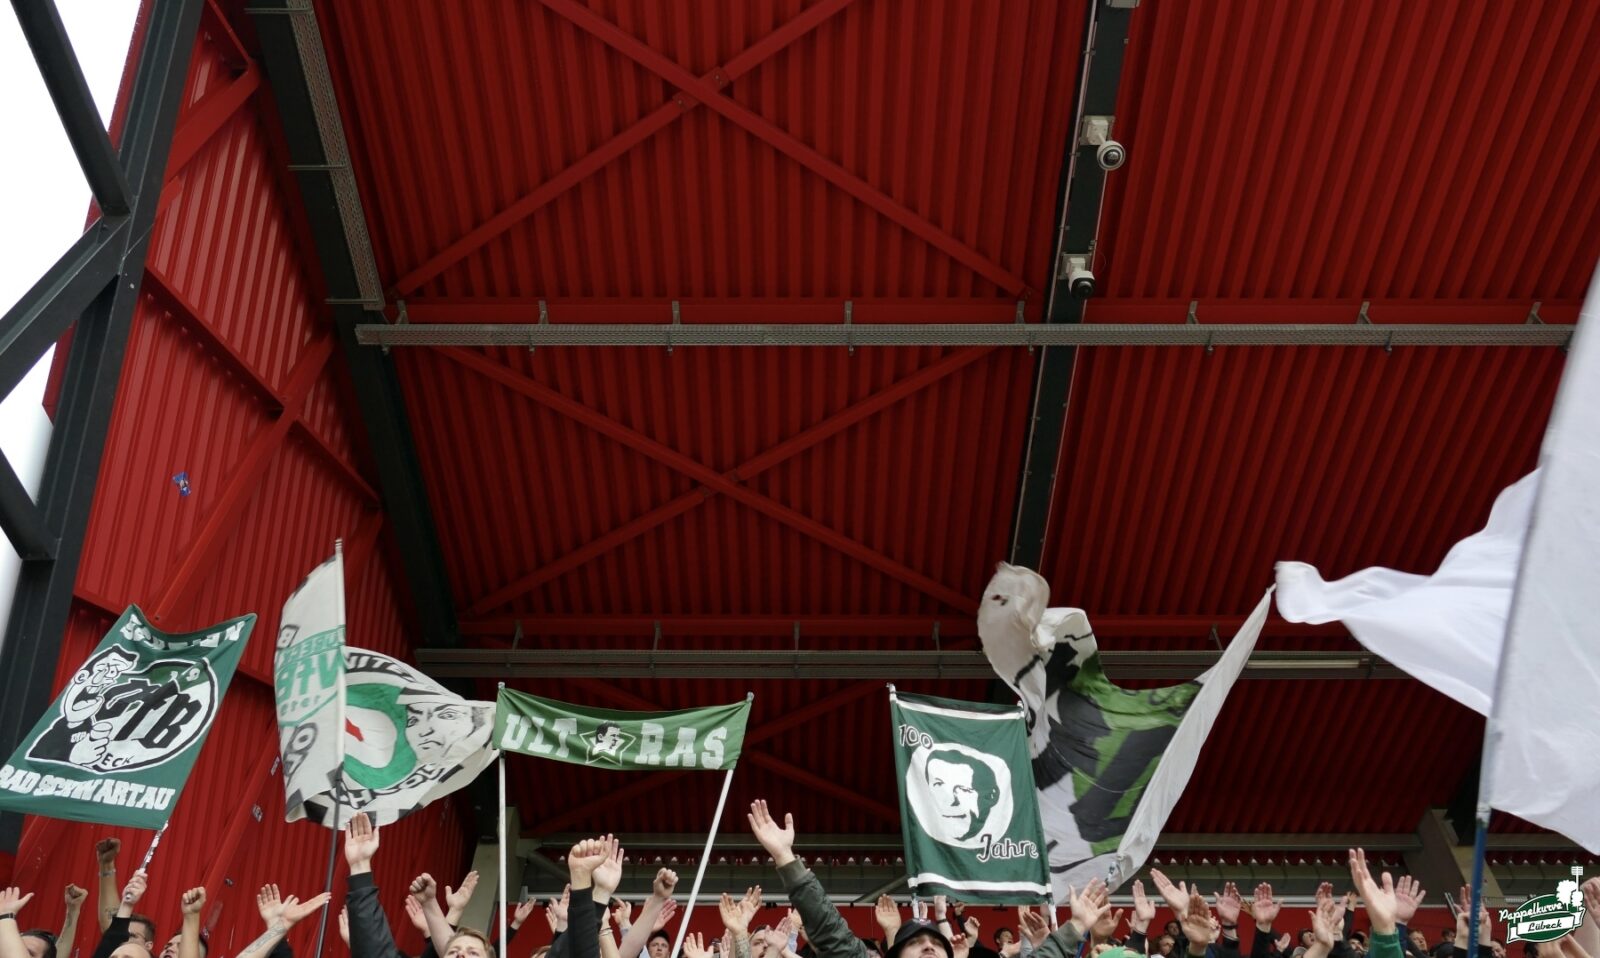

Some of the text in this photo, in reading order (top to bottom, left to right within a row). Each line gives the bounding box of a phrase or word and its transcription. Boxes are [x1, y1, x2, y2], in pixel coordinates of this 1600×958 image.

[898, 723, 935, 750] 100
[0, 764, 41, 794] BAD
[976, 833, 1039, 863] Jahre
